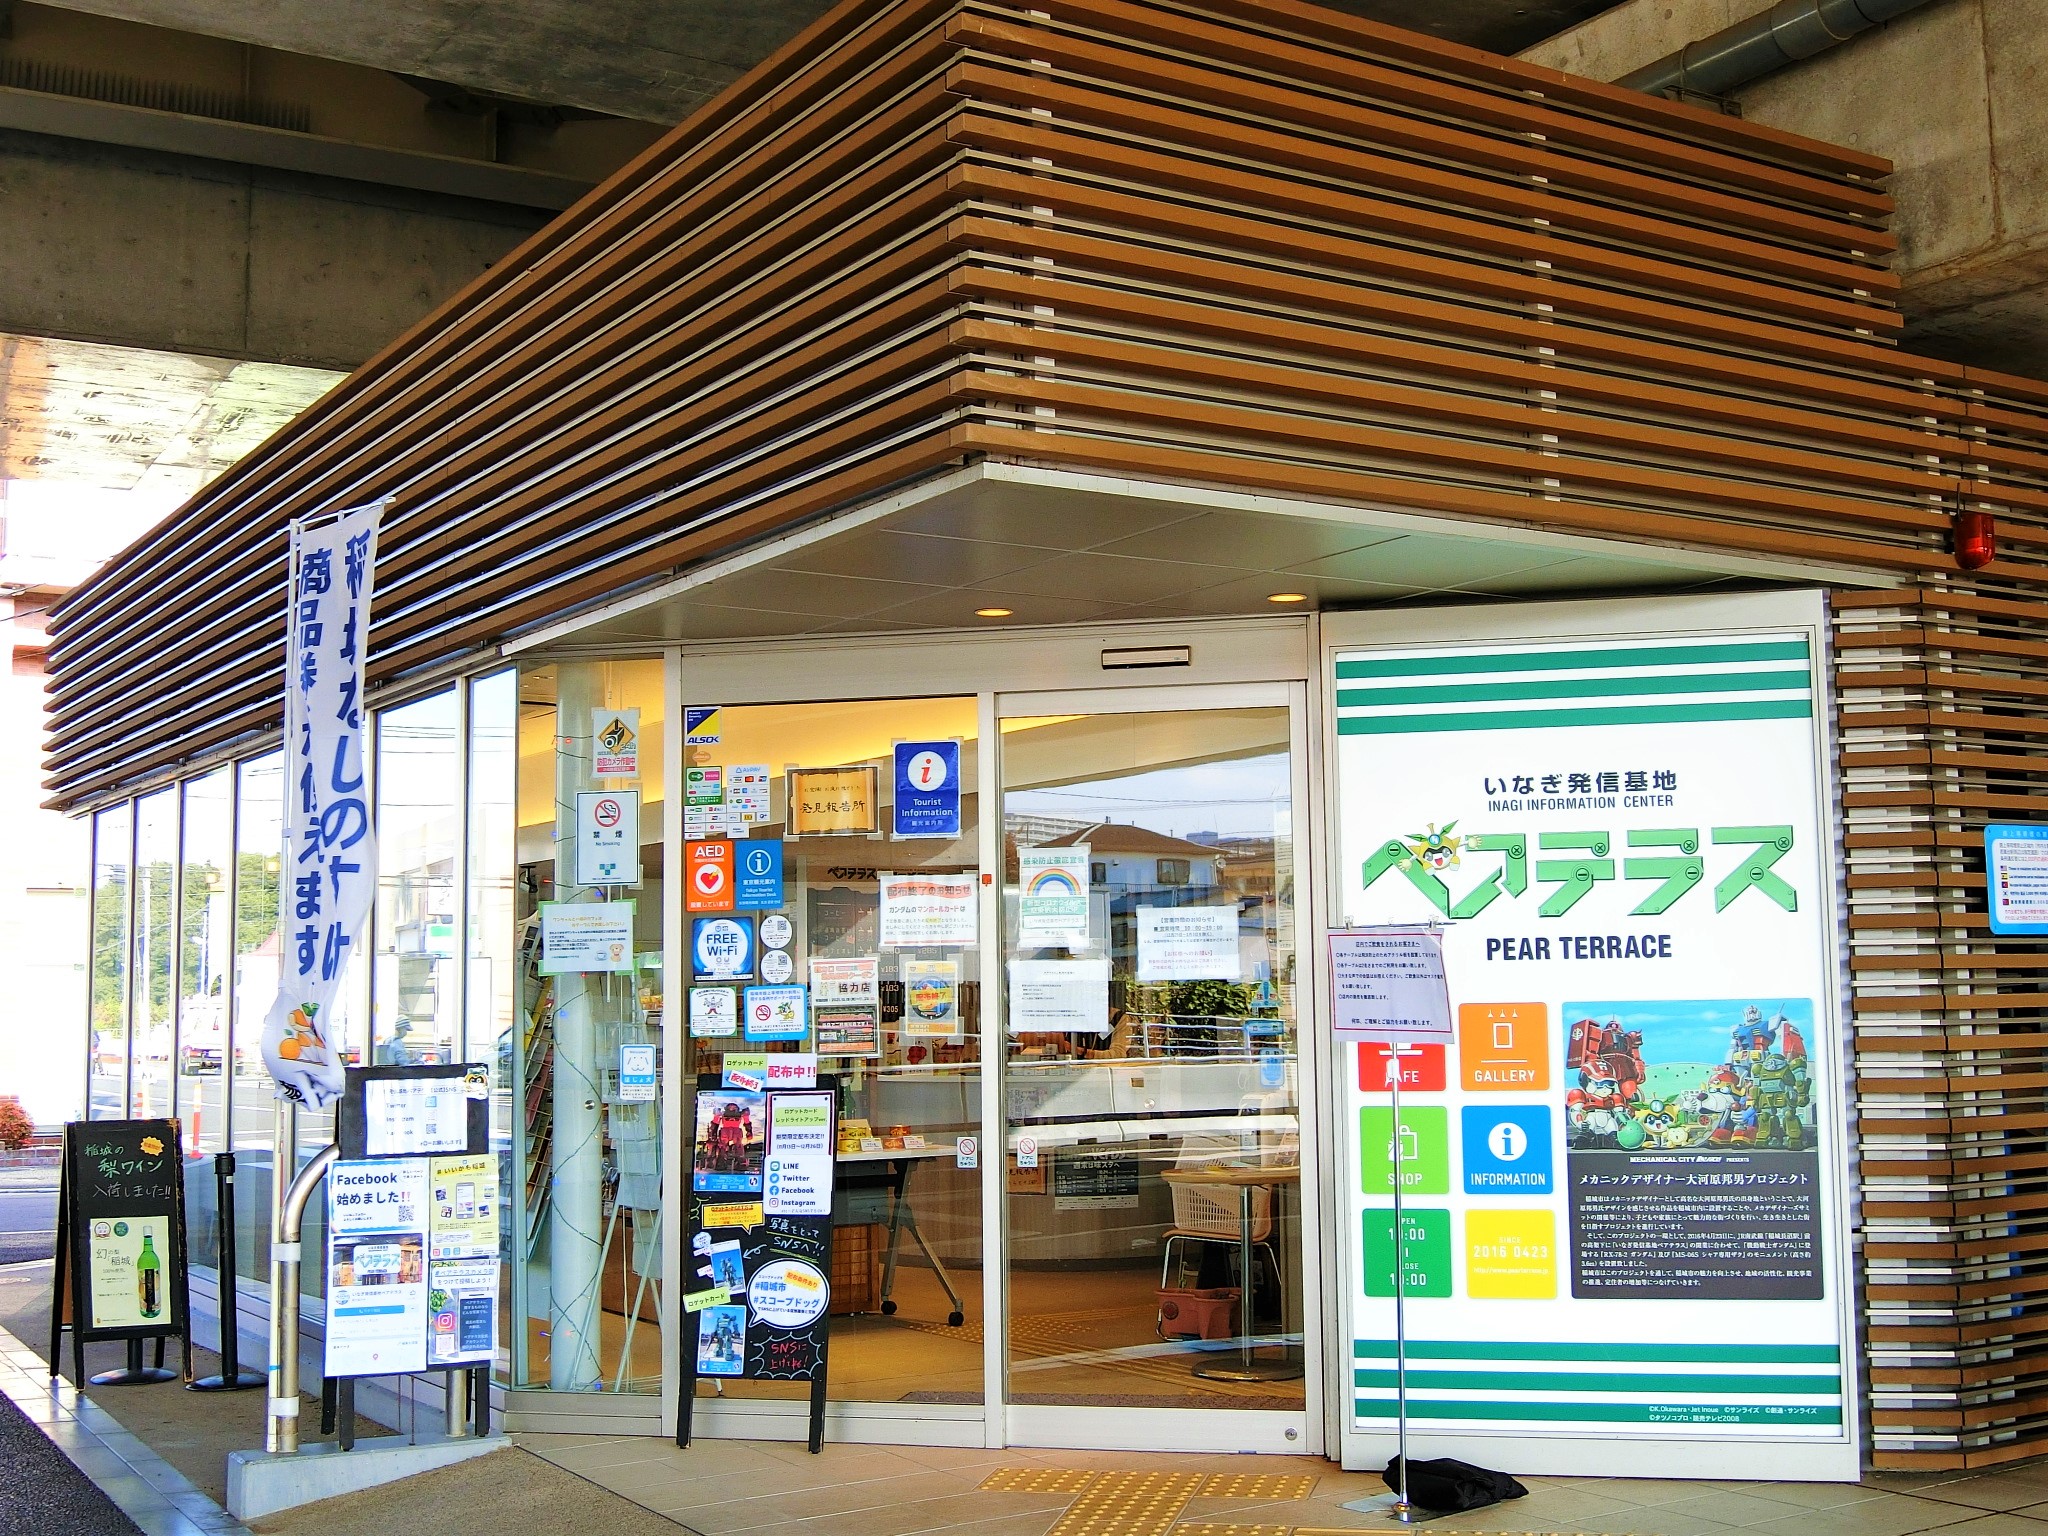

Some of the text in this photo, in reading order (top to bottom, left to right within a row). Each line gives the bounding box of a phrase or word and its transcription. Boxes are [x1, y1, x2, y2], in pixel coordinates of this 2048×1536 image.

[687, 736, 720, 744] ALSOK
[1483, 770, 1678, 796] いなぎ発信基地
[800, 800, 866, 814] 発見報告所
[912, 798, 942, 806] Tourist
[1488, 794, 1674, 812] INAGI INFORMATION CENTER
[901, 808, 953, 817] Information
[593, 830, 623, 838] 禁煙
[694, 845, 725, 858] AED
[1362, 824, 1799, 920] ペアテラス
[887, 885, 971, 897] 配布終了のお知らせ
[706, 933, 738, 944] FREE
[707, 946, 738, 956] Wi-Fi
[1486, 934, 1672, 961] PEAR TERRACE
[839, 982, 872, 994] 協力店
[915, 992, 947, 1002] 配布終了
[1474, 1069, 1535, 1083] GALLERY
[84, 1142, 125, 1157] 稲城の
[98, 1158, 164, 1180] 梨ワイン
[782, 1162, 799, 1170] LINE
[1073, 1161, 1120, 1170] 週末は味スタへ
[336, 1172, 398, 1186] Facebook
[782, 1174, 810, 1182] Twitter
[1470, 1172, 1546, 1186] INFORMATION
[1579, 1174, 1808, 1186] メカニックデザイナー大河原邦男プロジェクト
[768, 1217, 820, 1239] 写真をとって
[1388, 1228, 1426, 1241] 1:00
[1498, 1236, 1521, 1244] SINCE
[1473, 1245, 1548, 1258] 2016 0423
[786, 1272, 818, 1289] 配布条件あり
[1390, 1273, 1427, 1286] 1:00
[754, 1282, 787, 1292] #稲城市
[688, 1293, 726, 1307] ロゲットカード
[754, 1296, 820, 1308] #スコープドッグ
[770, 1342, 808, 1354] SNSに
[1724, 1406, 1760, 1414] ©サンライズ
